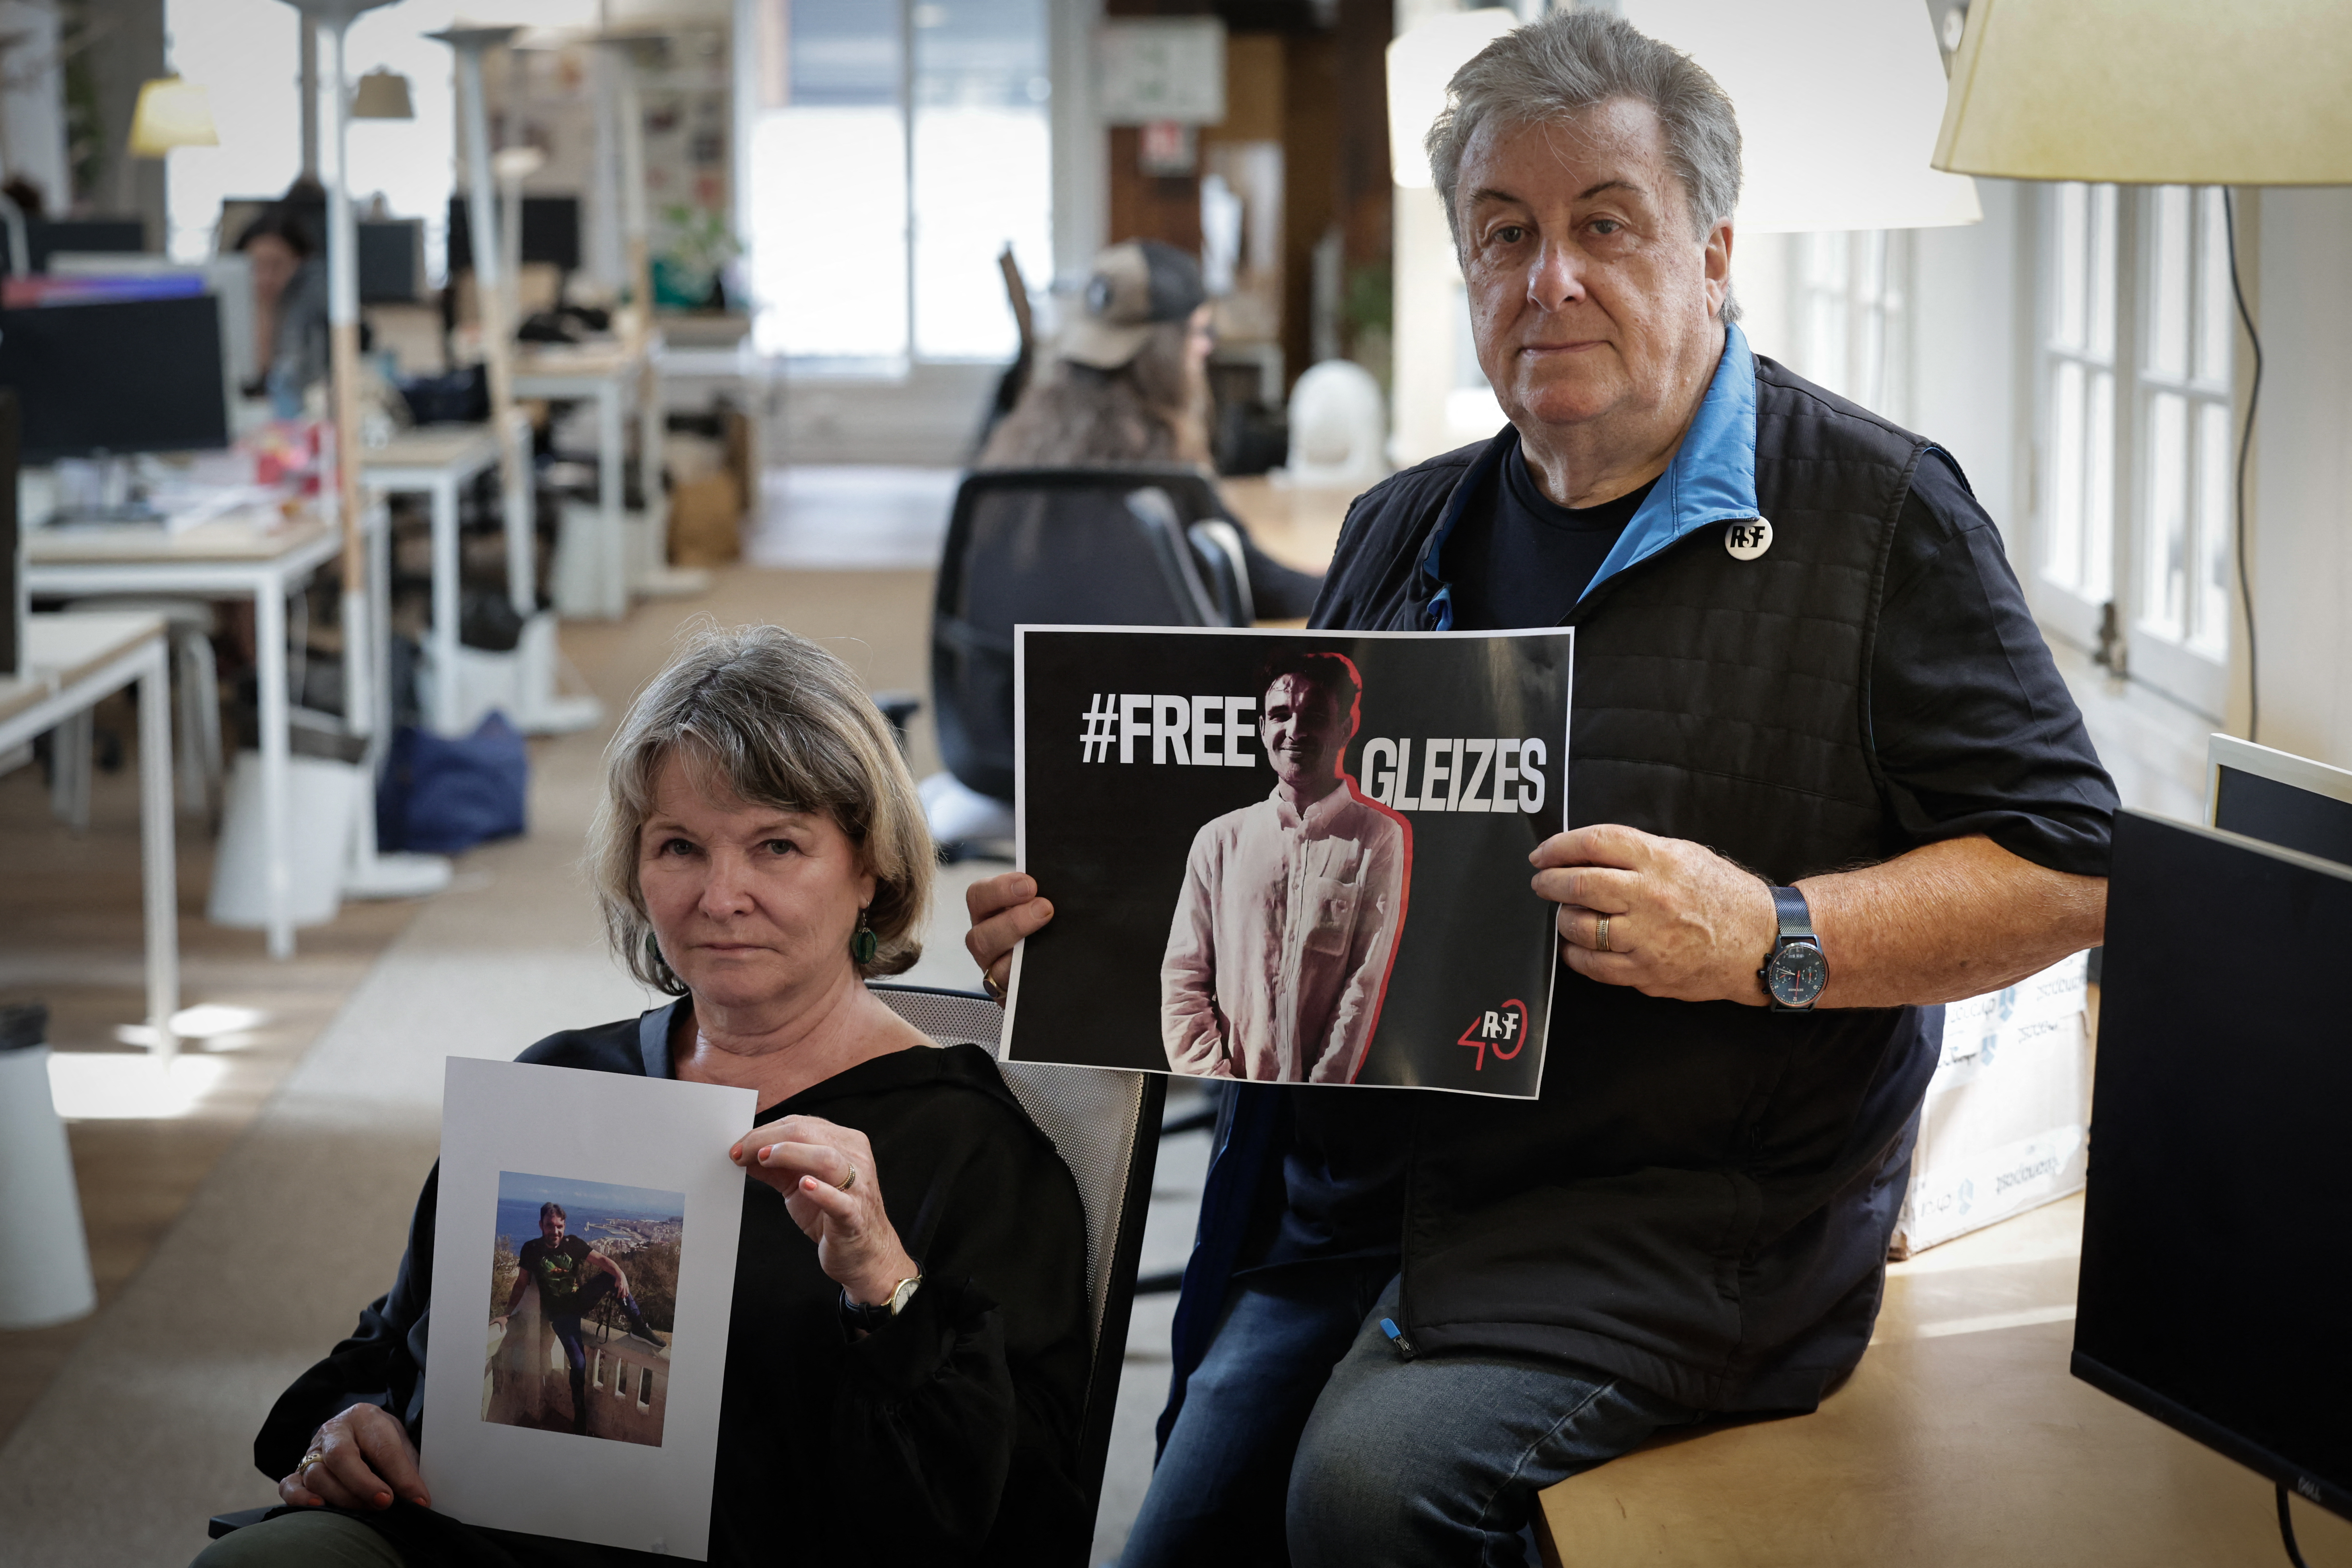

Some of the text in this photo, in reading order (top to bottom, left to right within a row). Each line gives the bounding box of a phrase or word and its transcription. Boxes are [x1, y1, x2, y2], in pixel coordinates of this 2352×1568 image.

[1730, 525, 1765, 547] RSF
[1080, 693, 1256, 767] #FREE
[1360, 737, 1547, 814] GLEIZES
[1482, 1011, 1519, 1039] RSF
